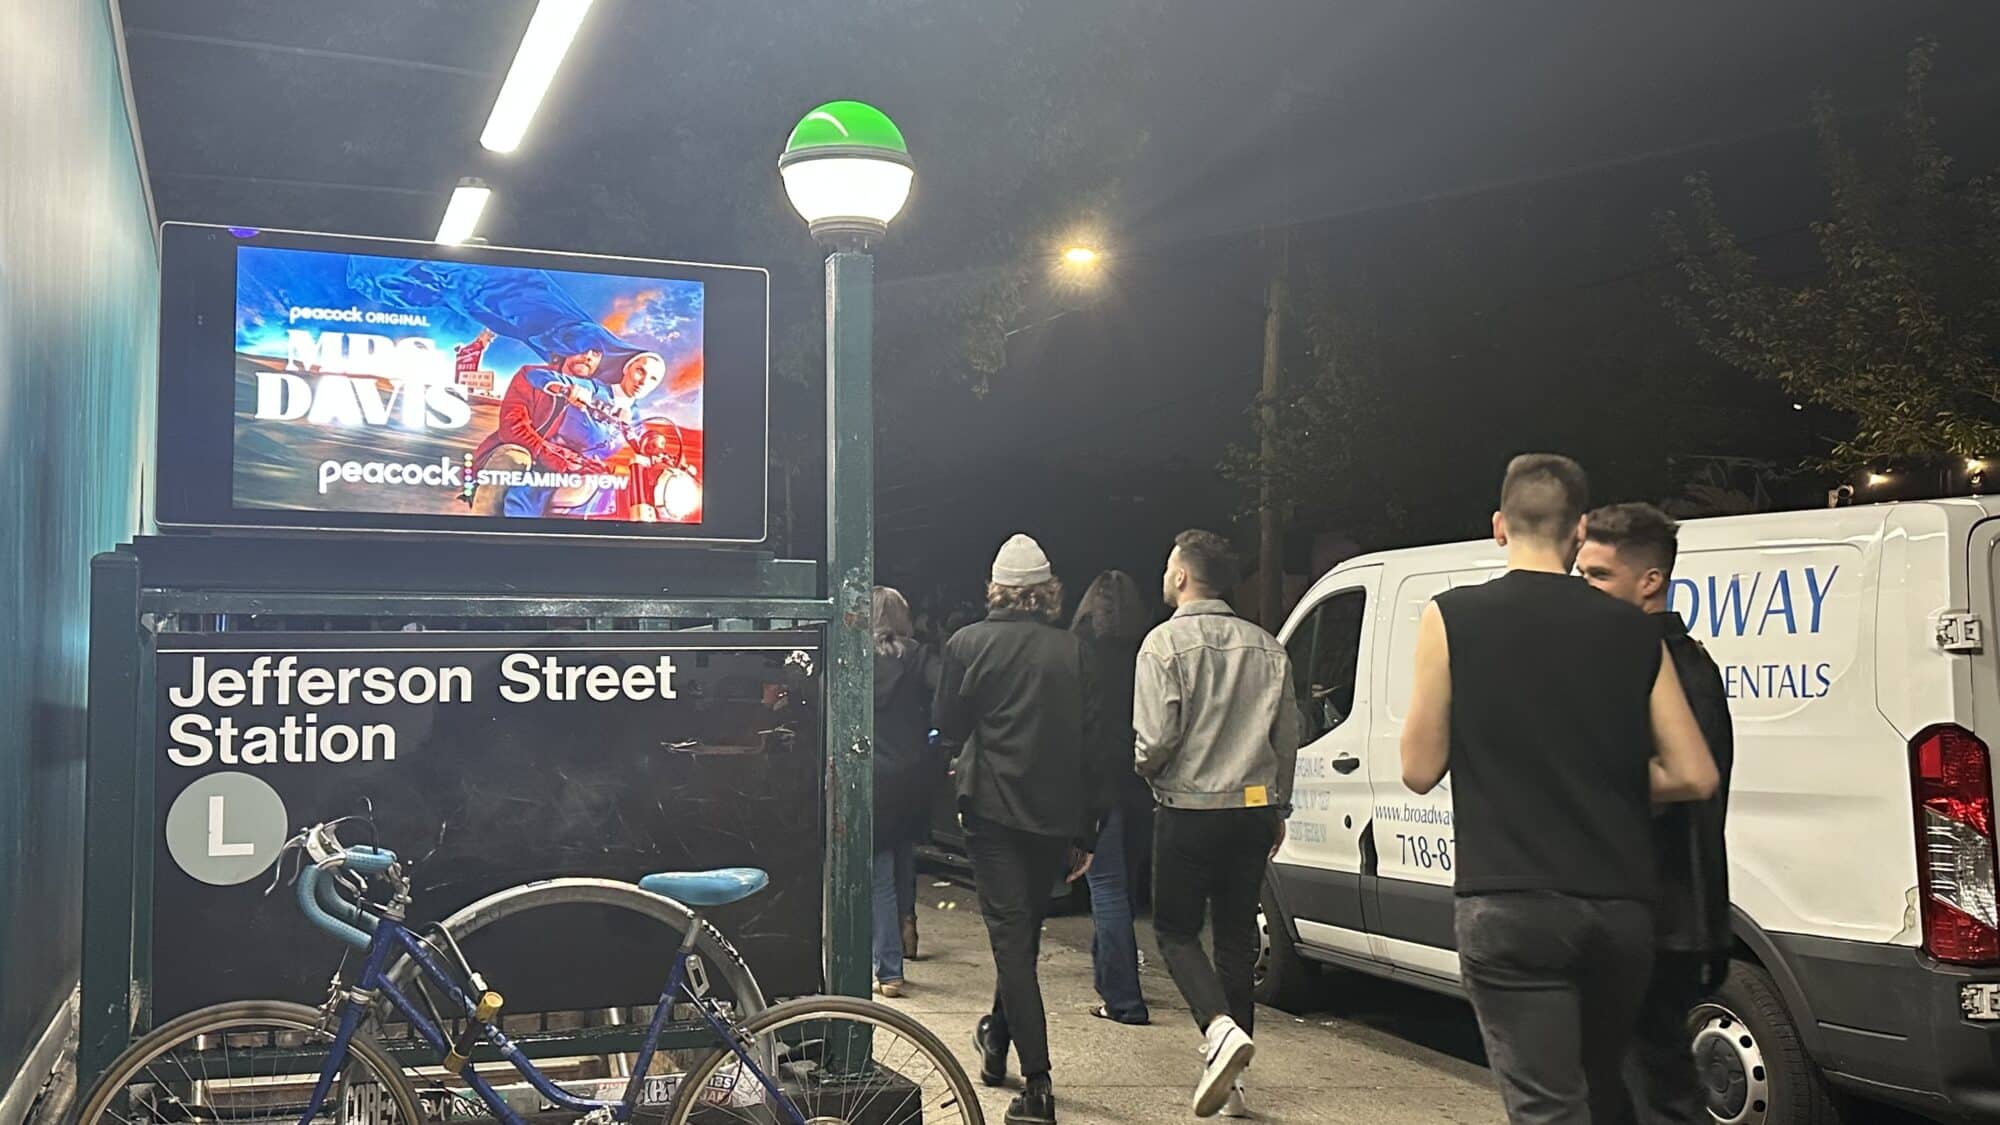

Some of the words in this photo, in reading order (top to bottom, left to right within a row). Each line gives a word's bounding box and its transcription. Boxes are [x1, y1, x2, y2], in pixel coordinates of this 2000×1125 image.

[289, 306, 363, 324] peacock
[365, 312, 430, 327] ORIGINAL
[254, 371, 472, 430] DAVIS
[318, 456, 461, 494] peacock
[477, 469, 582, 489] STREAMING
[585, 474, 629, 490] NOW
[168, 655, 473, 709] Jefferson
[498, 652, 678, 703] Street
[166, 713, 397, 767] Station
[207, 795, 255, 857] L
